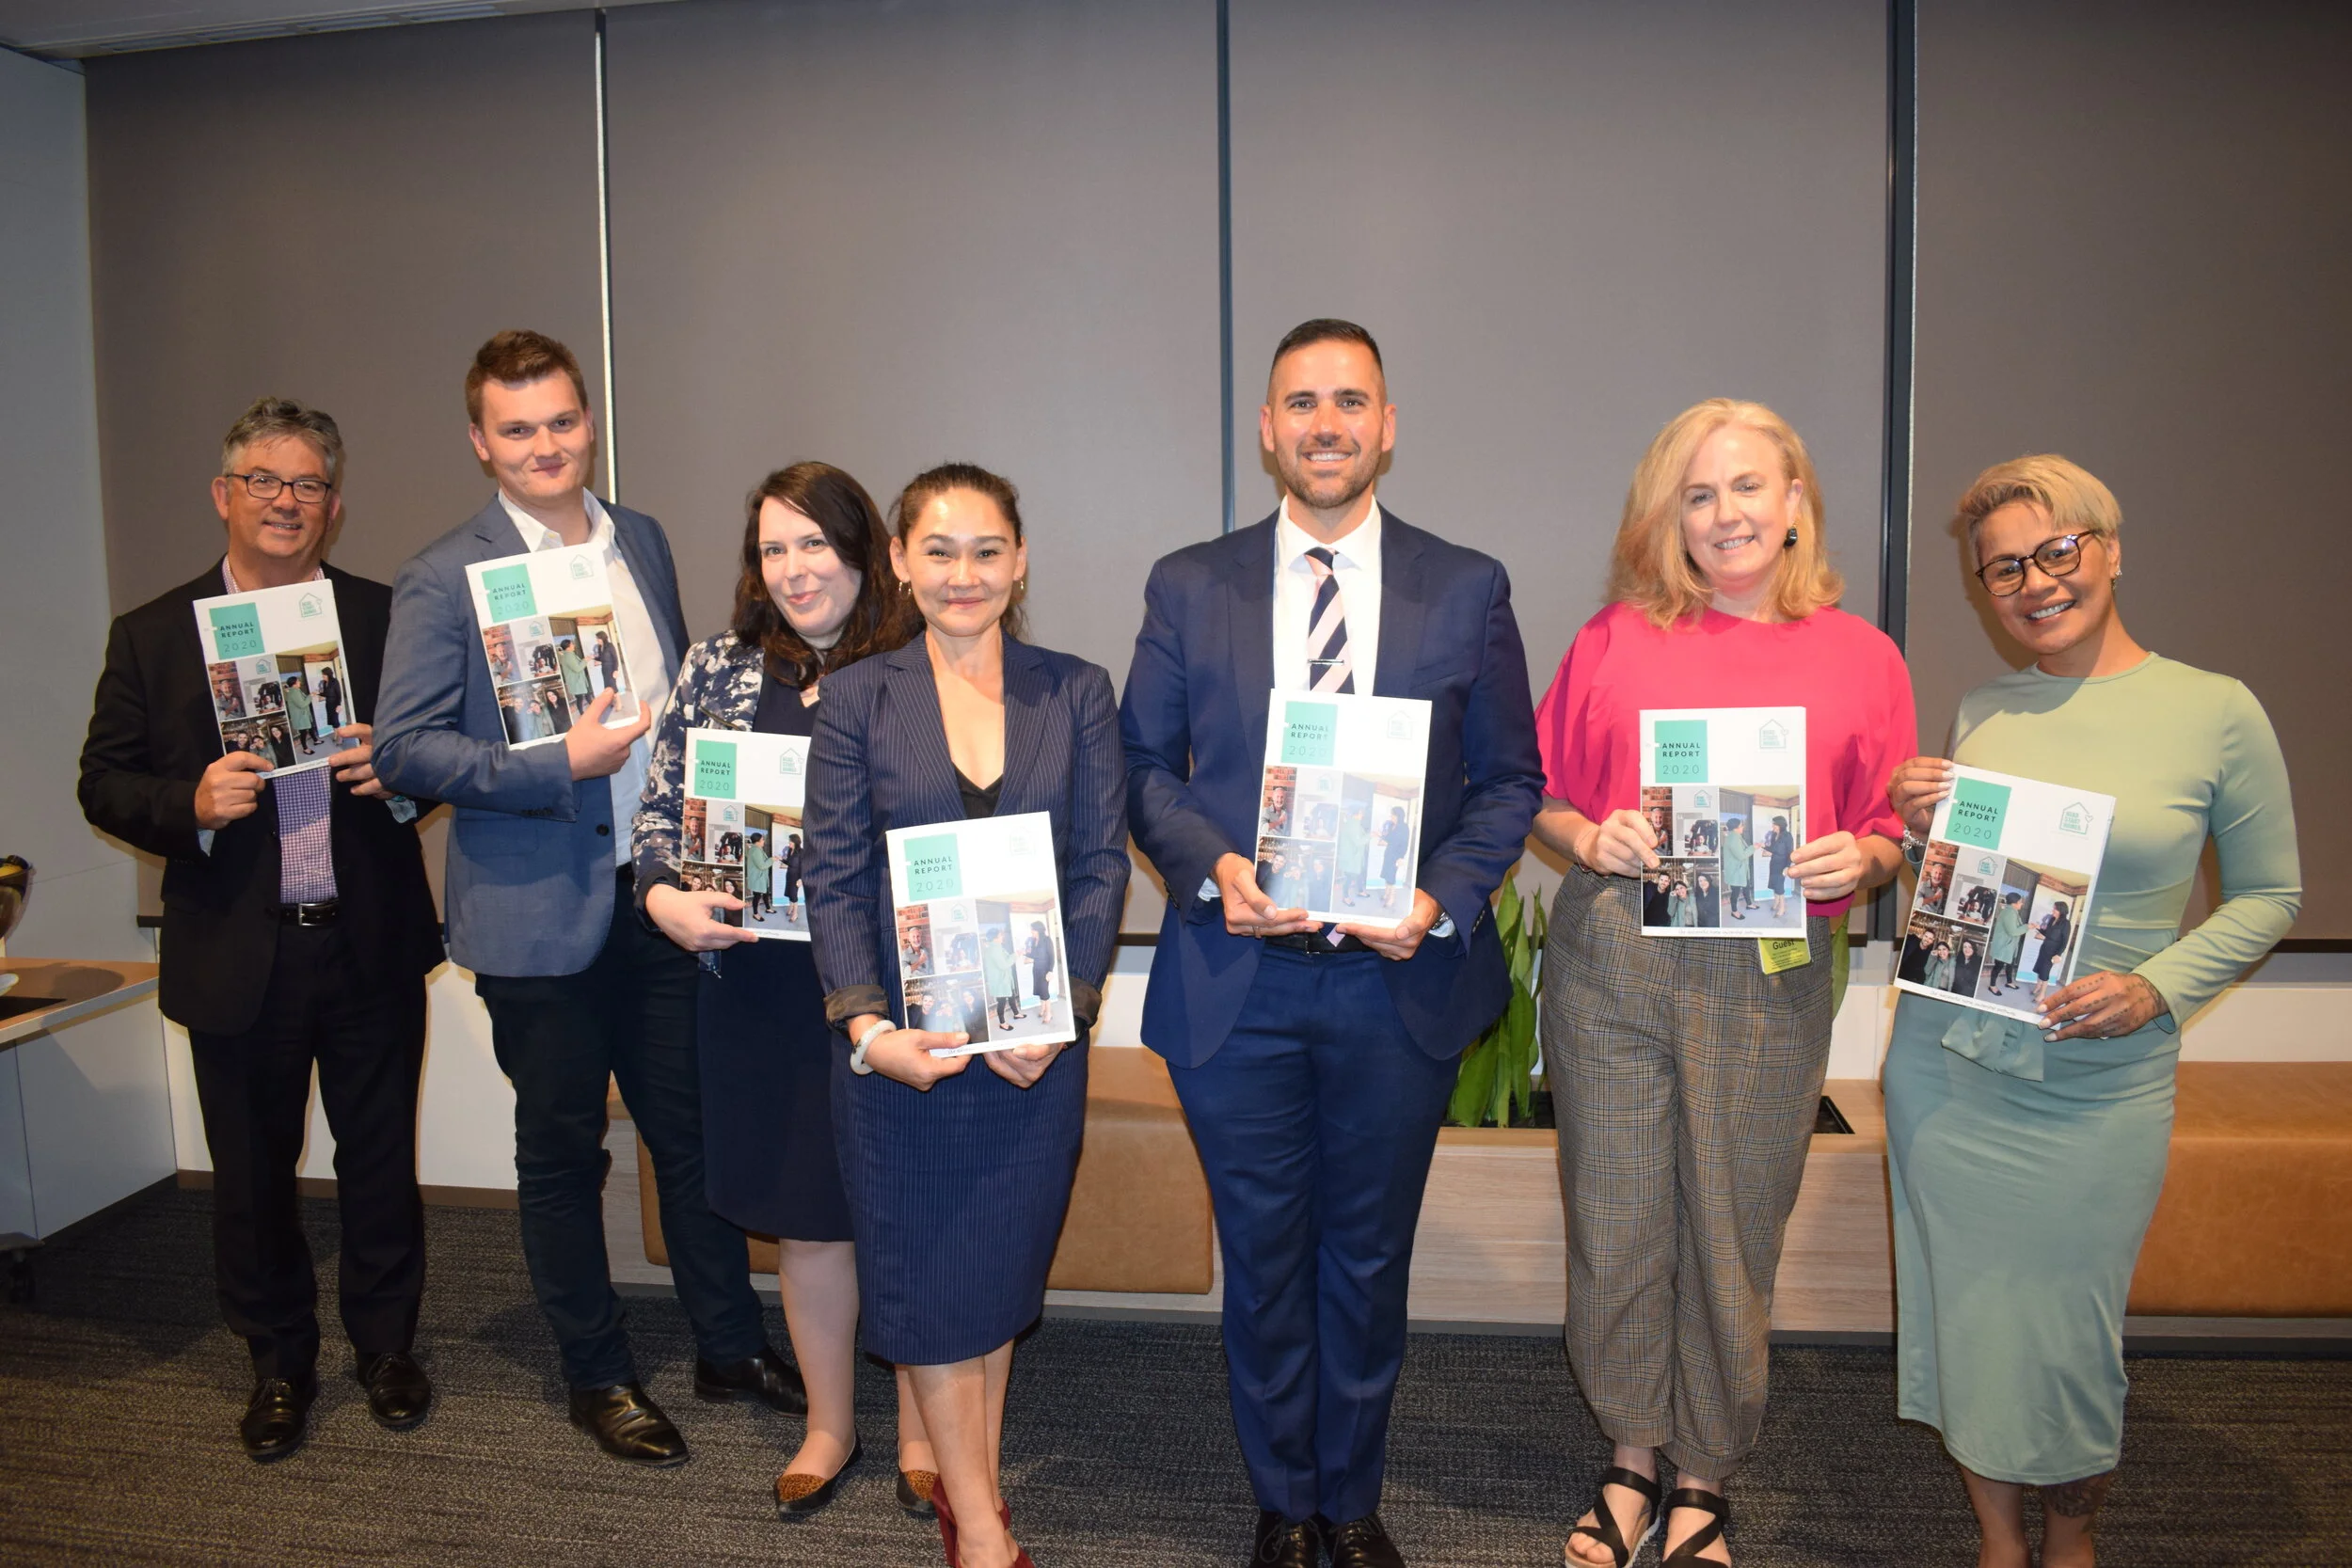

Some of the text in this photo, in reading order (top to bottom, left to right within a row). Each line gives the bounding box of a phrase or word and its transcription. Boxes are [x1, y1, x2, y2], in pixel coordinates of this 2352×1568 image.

[492, 583, 526, 594] ANNUAL
[494, 589, 526, 600] REPORT
[220, 622, 254, 631] ANNUAL
[221, 627, 254, 638] REPORT
[223, 640, 256, 653] 2020
[1290, 723, 1328, 732] ANNUAL
[1291, 731, 1327, 740] REPORT
[700, 759, 731, 768] ANNUAL
[700, 767, 730, 776] REPORT
[1662, 764, 1700, 775] 2020
[699, 779, 730, 791] 2020
[1959, 800, 1998, 815] ANNUAL
[1958, 808, 1996, 823] REPORT
[1953, 822, 1992, 840] 2020
[914, 856, 952, 866] ANNUAL
[914, 864, 952, 875] REPORT
[916, 879, 954, 893] 2020
[1772, 939, 1795, 950] Guest
